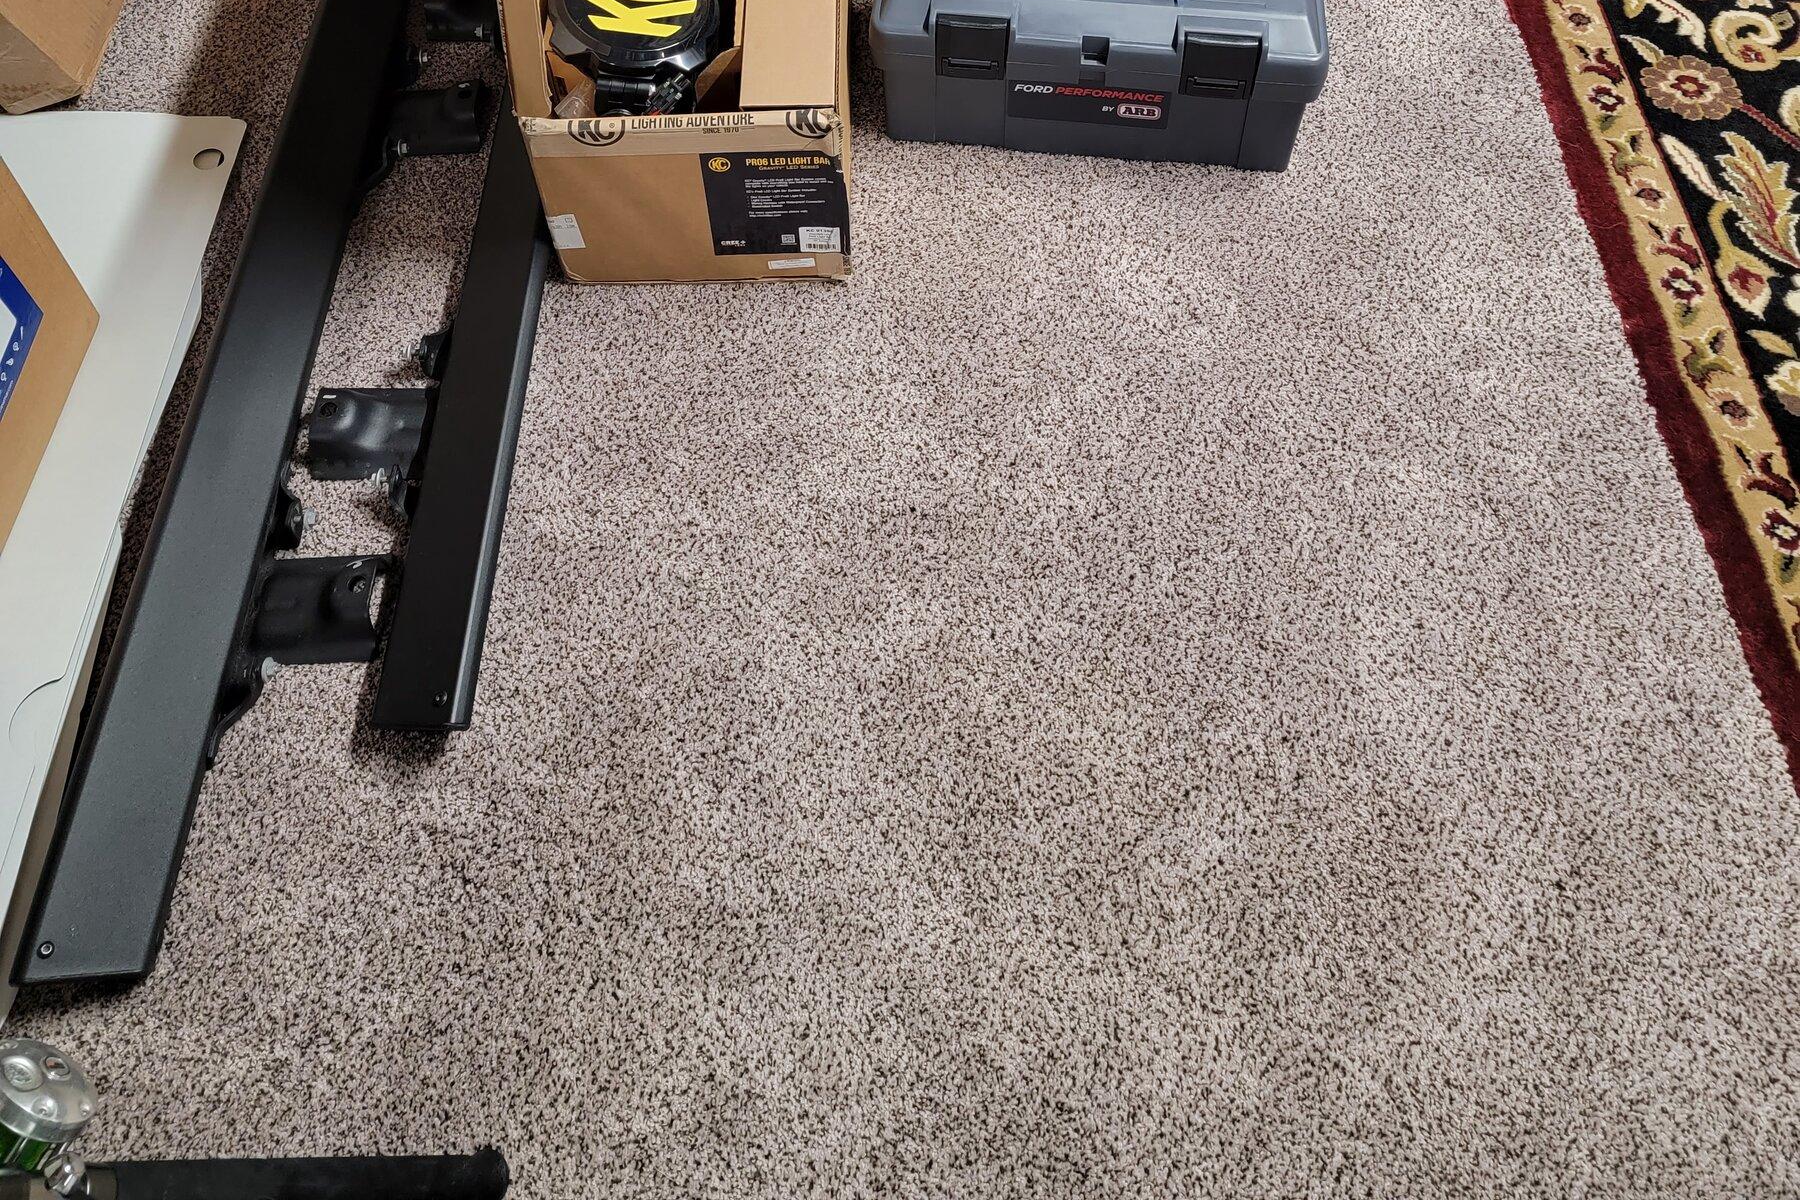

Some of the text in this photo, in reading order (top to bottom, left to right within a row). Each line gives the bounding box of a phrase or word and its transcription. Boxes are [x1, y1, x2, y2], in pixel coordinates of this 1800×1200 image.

[1014, 83, 1165, 103] FORD PERFORMANCE
[1122, 106, 1157, 117] ARB
[631, 113, 755, 130] LIGHTING ADVENTURE
[577, 120, 615, 141] KC
[702, 127, 722, 135] SINCE
[711, 159, 727, 171] KC
[770, 157, 786, 166] LED
[787, 156, 813, 165] LIGHT
[813, 156, 831, 166] BAR
